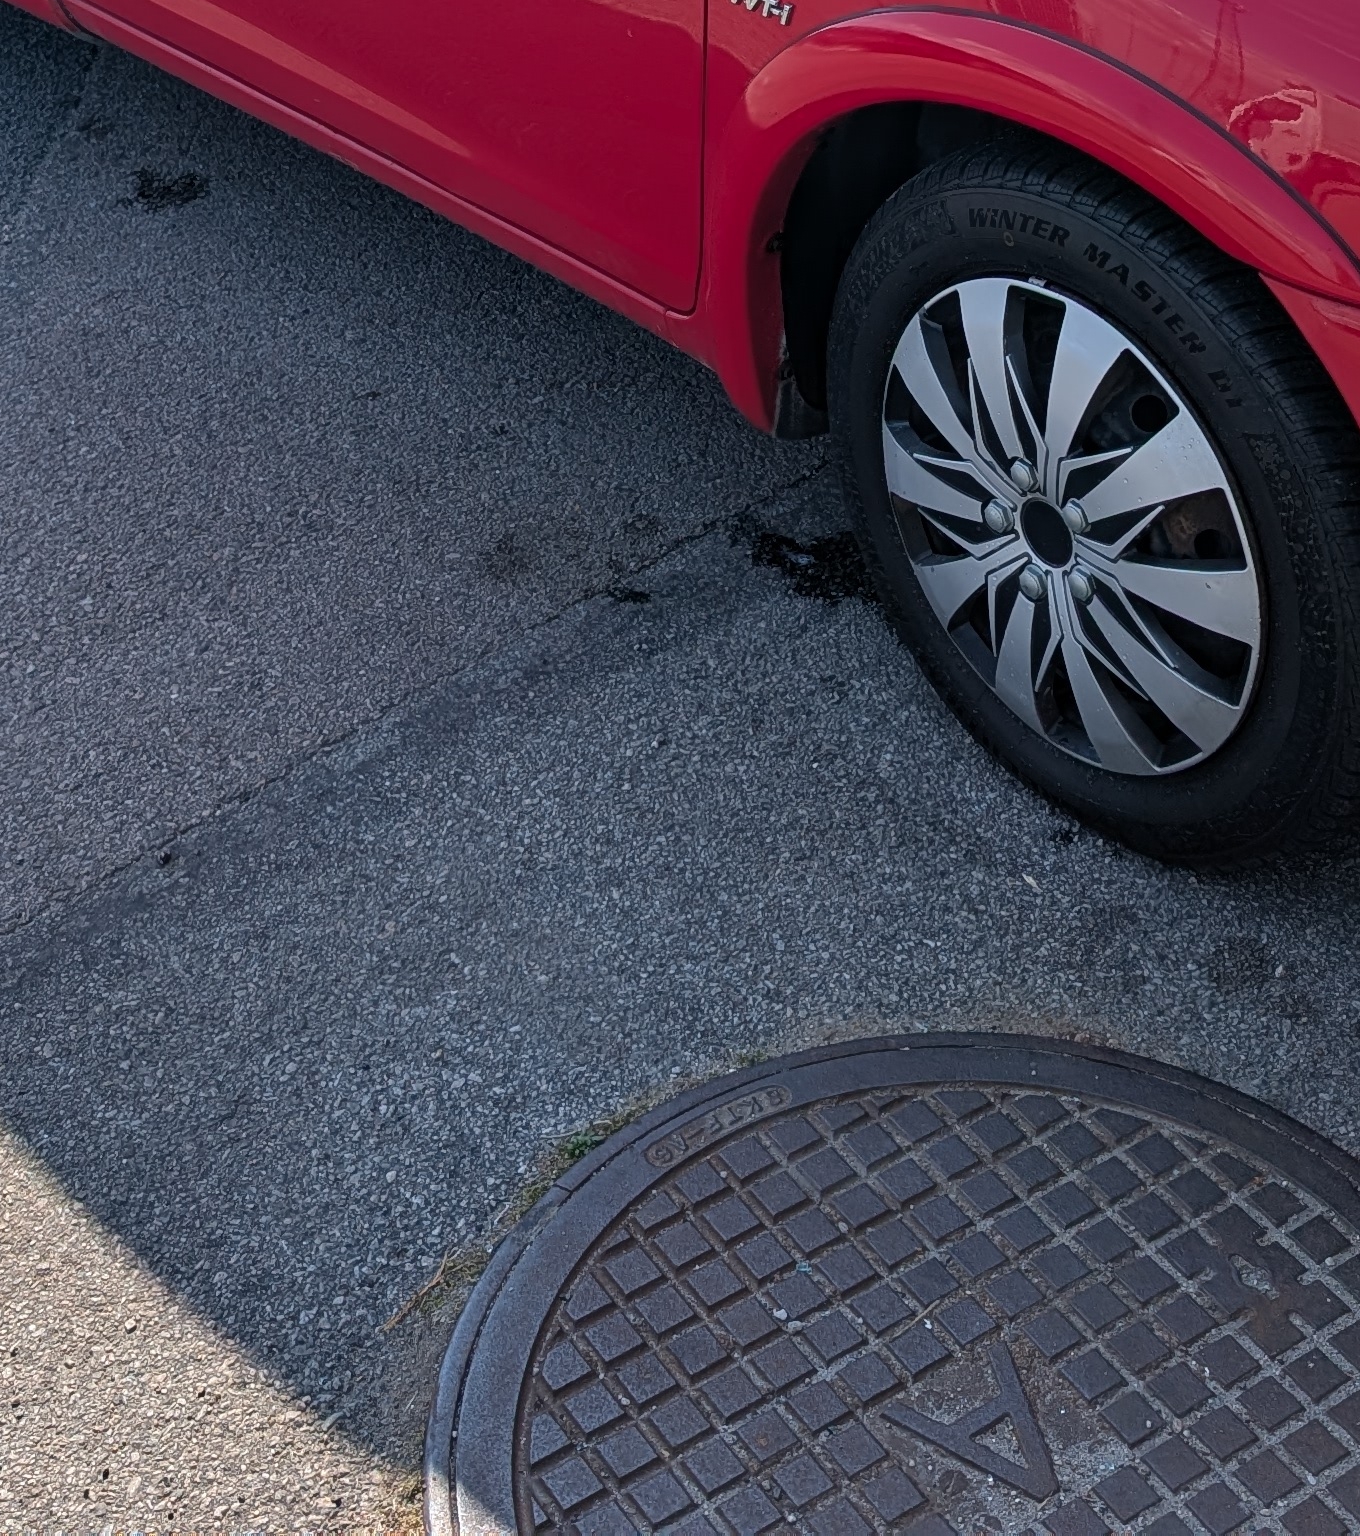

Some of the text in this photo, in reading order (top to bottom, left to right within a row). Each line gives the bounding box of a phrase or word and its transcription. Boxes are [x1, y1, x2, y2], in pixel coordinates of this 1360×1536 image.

[968, 206, 1071, 248] WINTER
[1083, 242, 1208, 356] MASTER
[879, 1340, 1061, 1504] A
